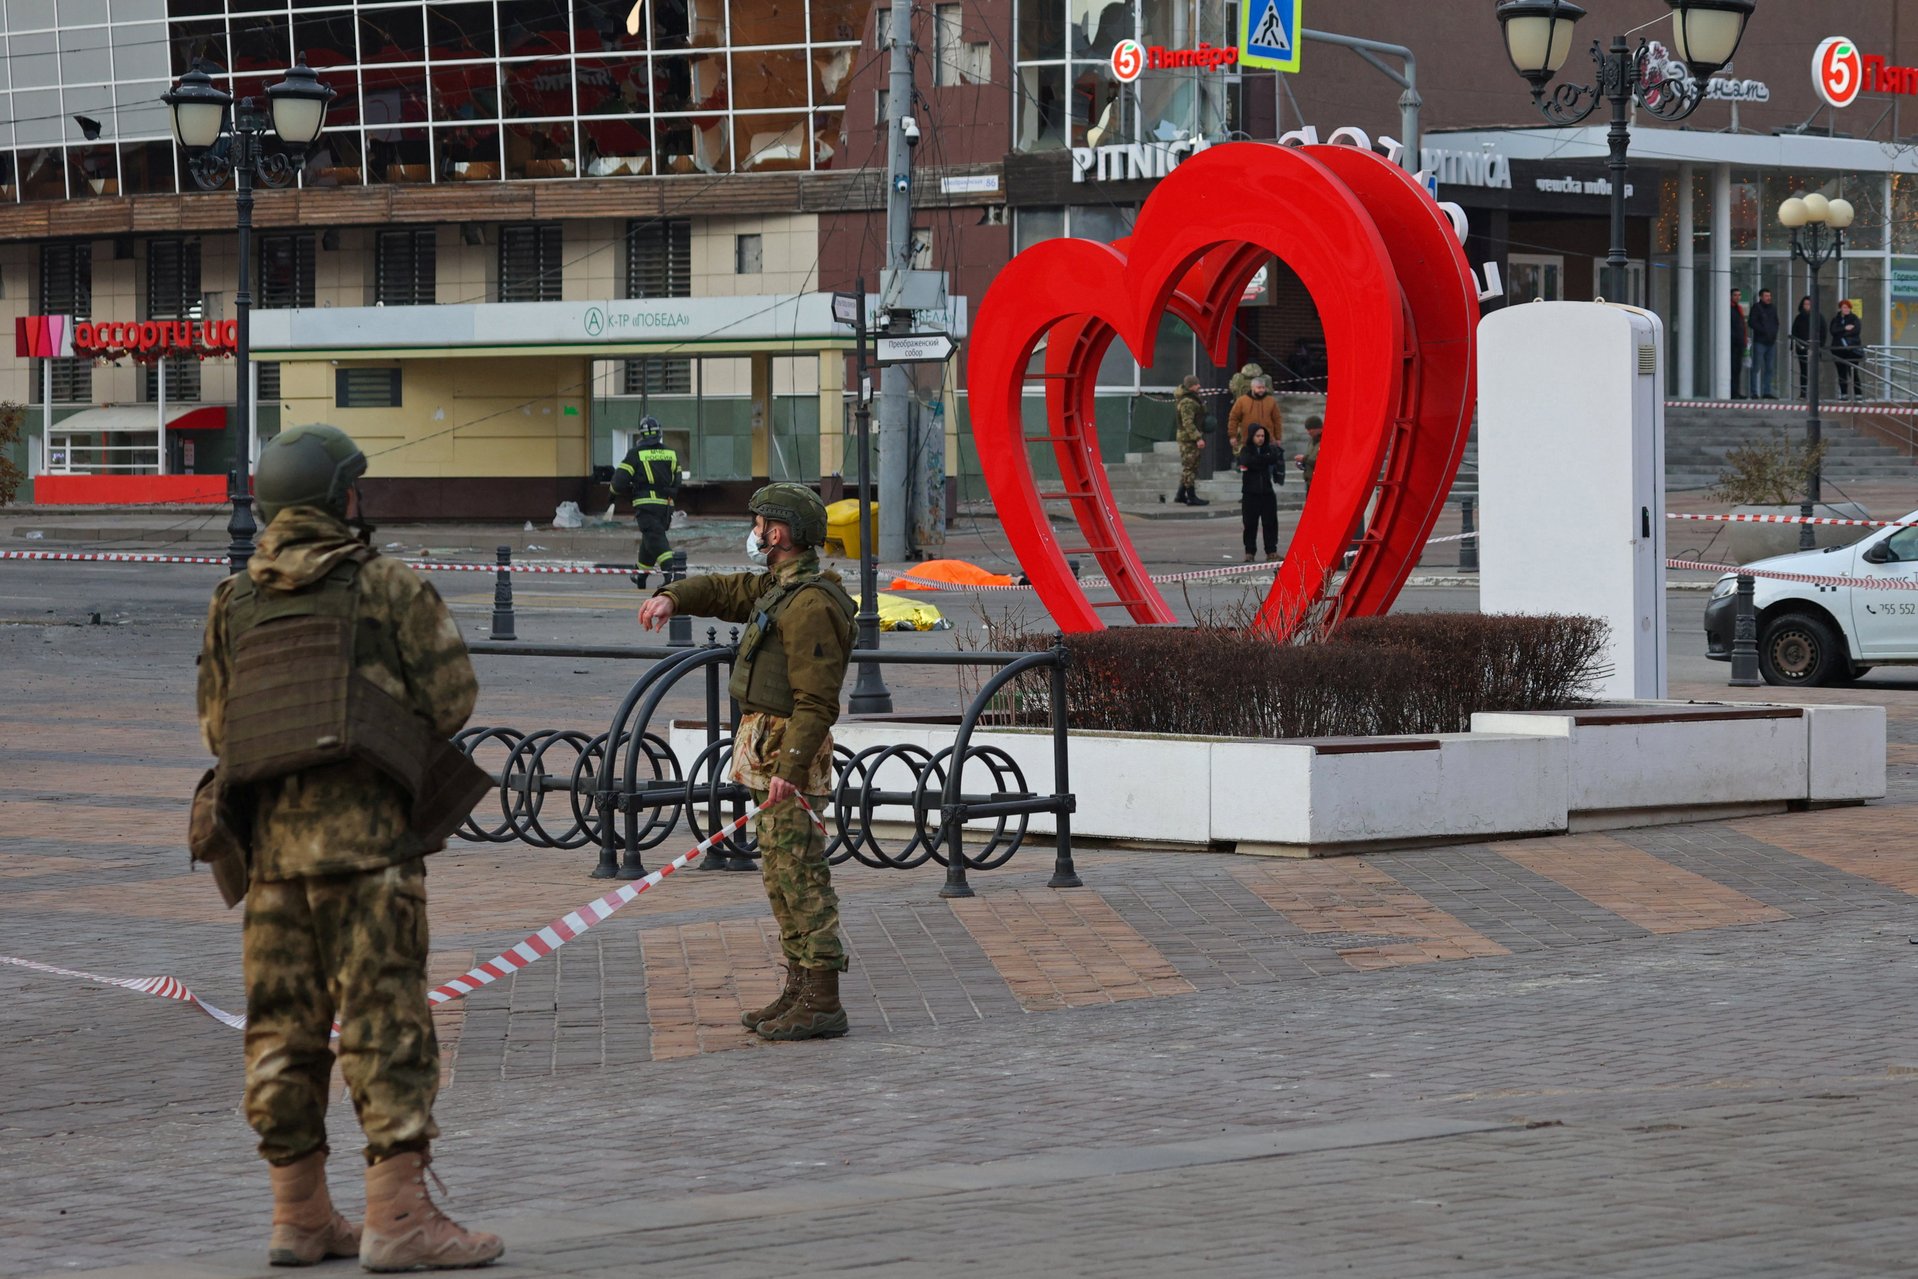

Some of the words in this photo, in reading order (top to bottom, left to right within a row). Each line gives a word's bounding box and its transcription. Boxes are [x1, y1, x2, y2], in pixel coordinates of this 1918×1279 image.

[1148, 42, 1239, 72] Пятёро
[1862, 54, 1918, 96] Пят
[888, 339, 939, 350] Преображенский
[905, 349, 923, 357] собор
[1900, 604, 1916, 615] 552
